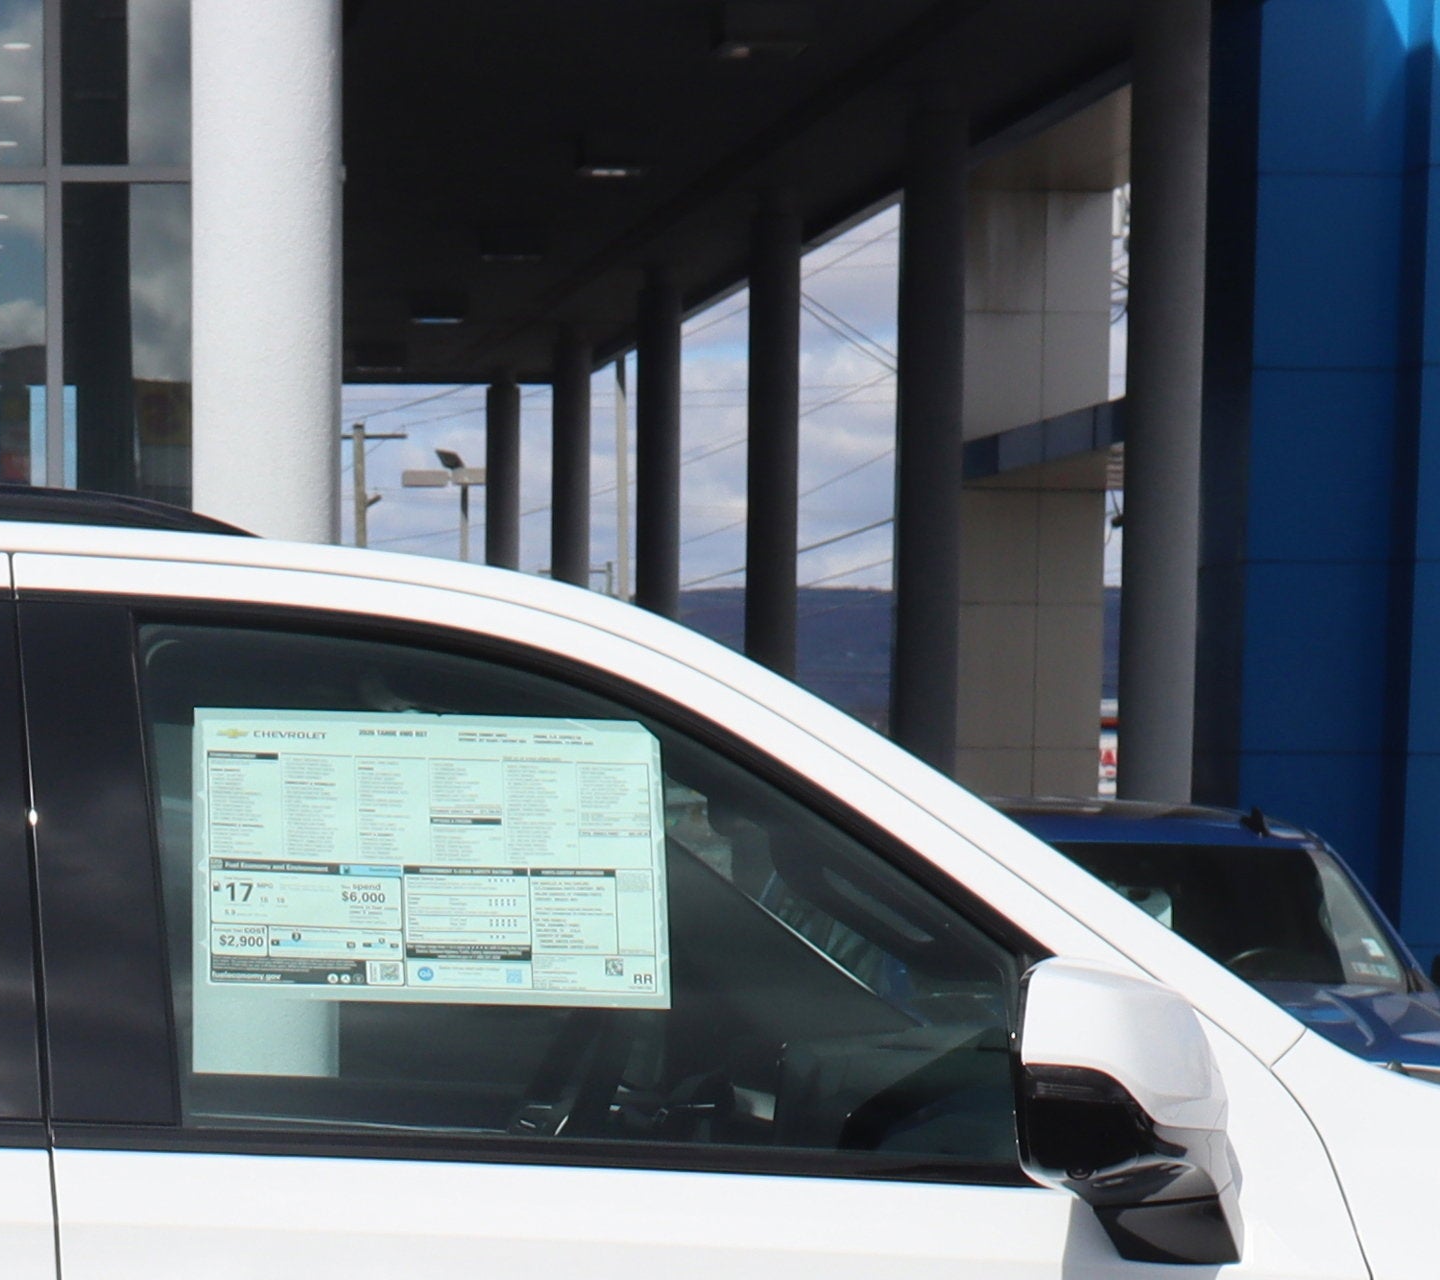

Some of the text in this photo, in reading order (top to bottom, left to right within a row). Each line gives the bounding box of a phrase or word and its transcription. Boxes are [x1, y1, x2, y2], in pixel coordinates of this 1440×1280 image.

[253, 730, 327, 740] CHEVROLET
[226, 882, 253, 902] 17
[341, 891, 385, 904] $6,000
[219, 935, 264, 948] $2,900
[633, 974, 653, 984] RR
